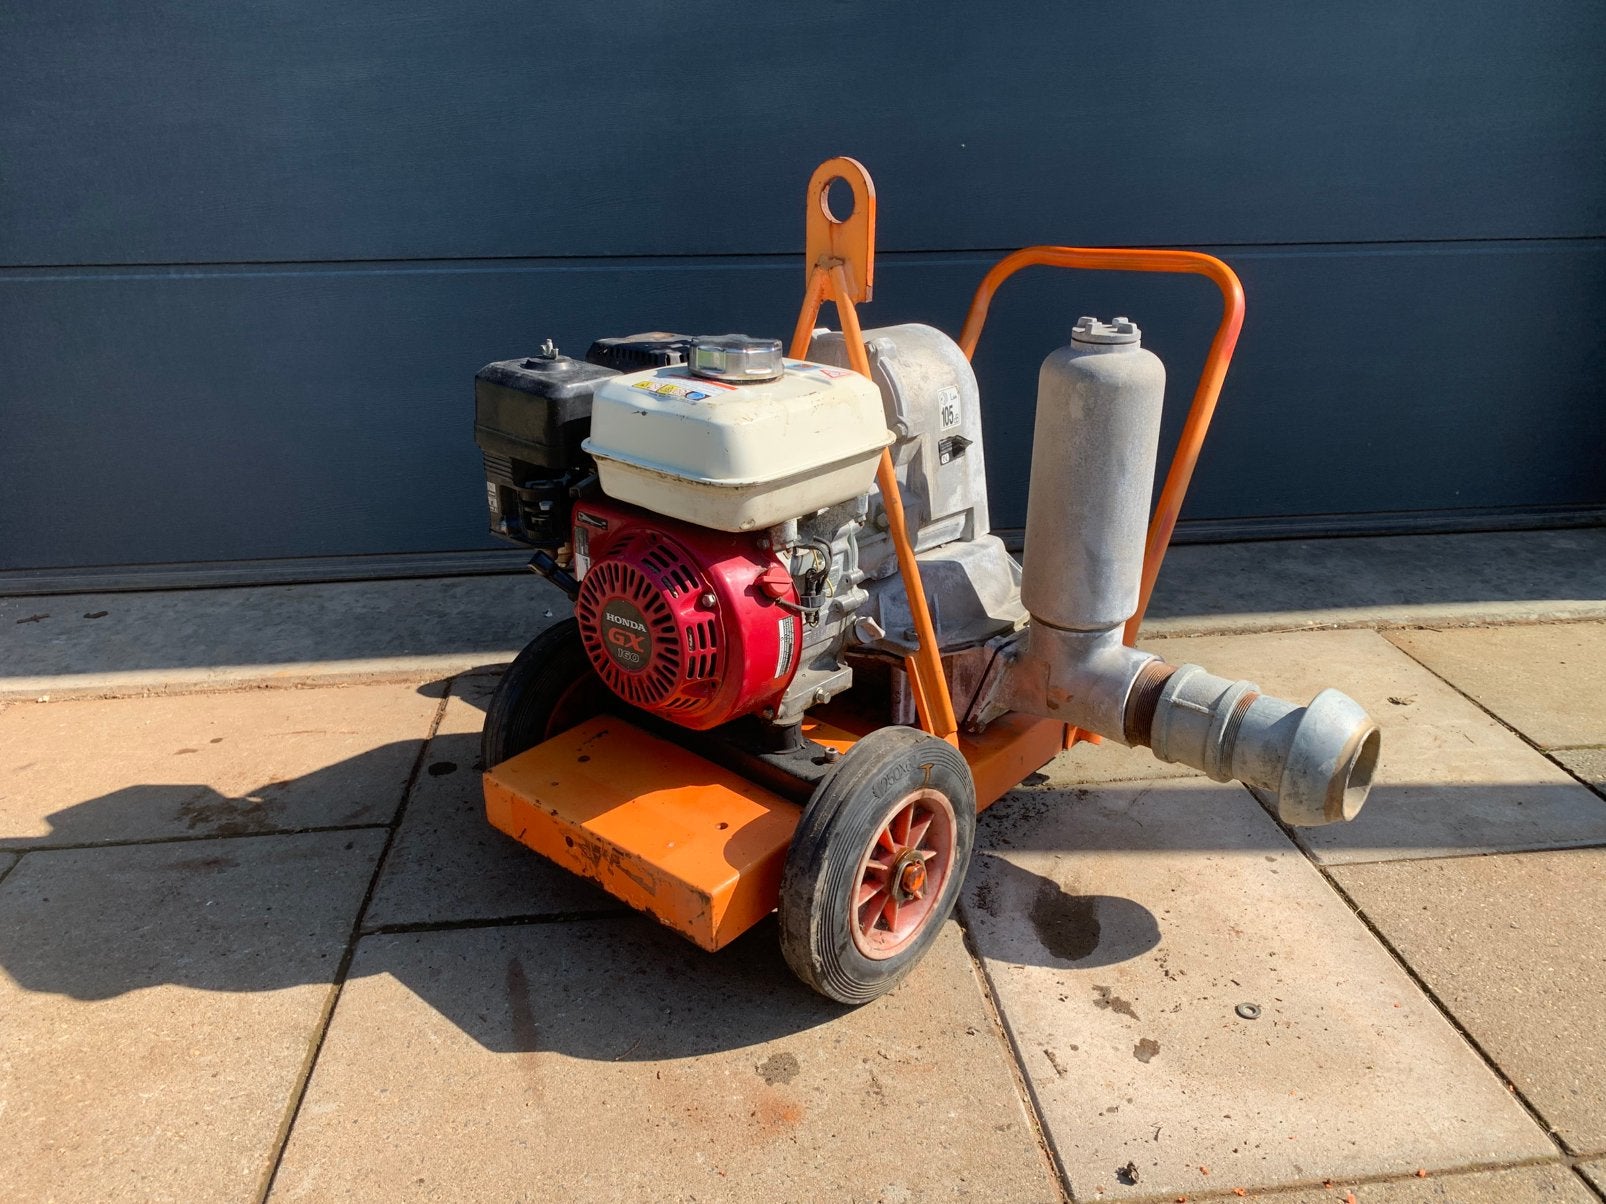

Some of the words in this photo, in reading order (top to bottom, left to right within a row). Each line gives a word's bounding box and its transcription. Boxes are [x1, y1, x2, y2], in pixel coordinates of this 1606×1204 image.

[941, 404, 954, 427] 105
[606, 612, 647, 633] HONDA
[608, 627, 645, 653] GX
